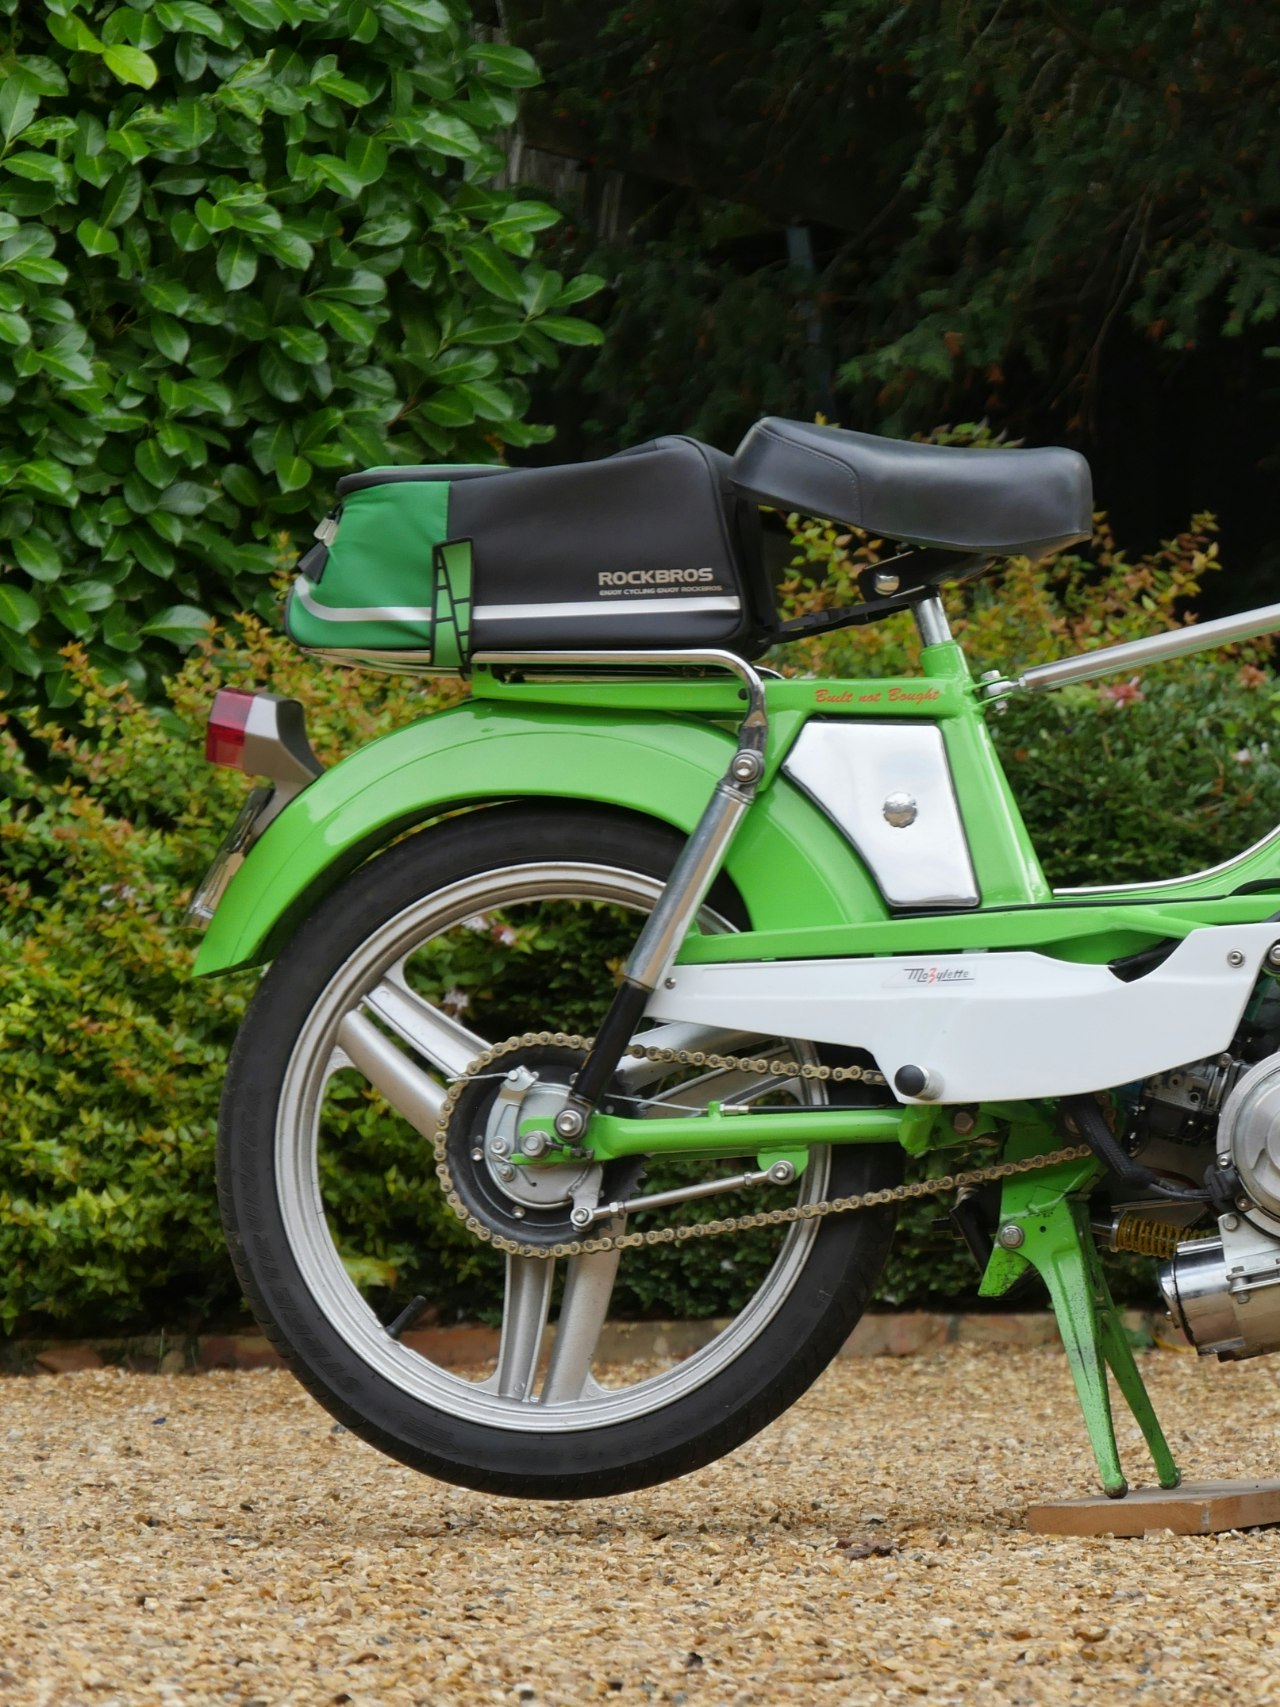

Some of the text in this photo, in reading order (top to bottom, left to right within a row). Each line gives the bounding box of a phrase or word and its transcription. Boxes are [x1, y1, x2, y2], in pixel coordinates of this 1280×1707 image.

[598, 567, 714, 586] ROCKBROS
[623, 587, 656, 595] CYCLING
[815, 687, 940, 705] Built not Bought
